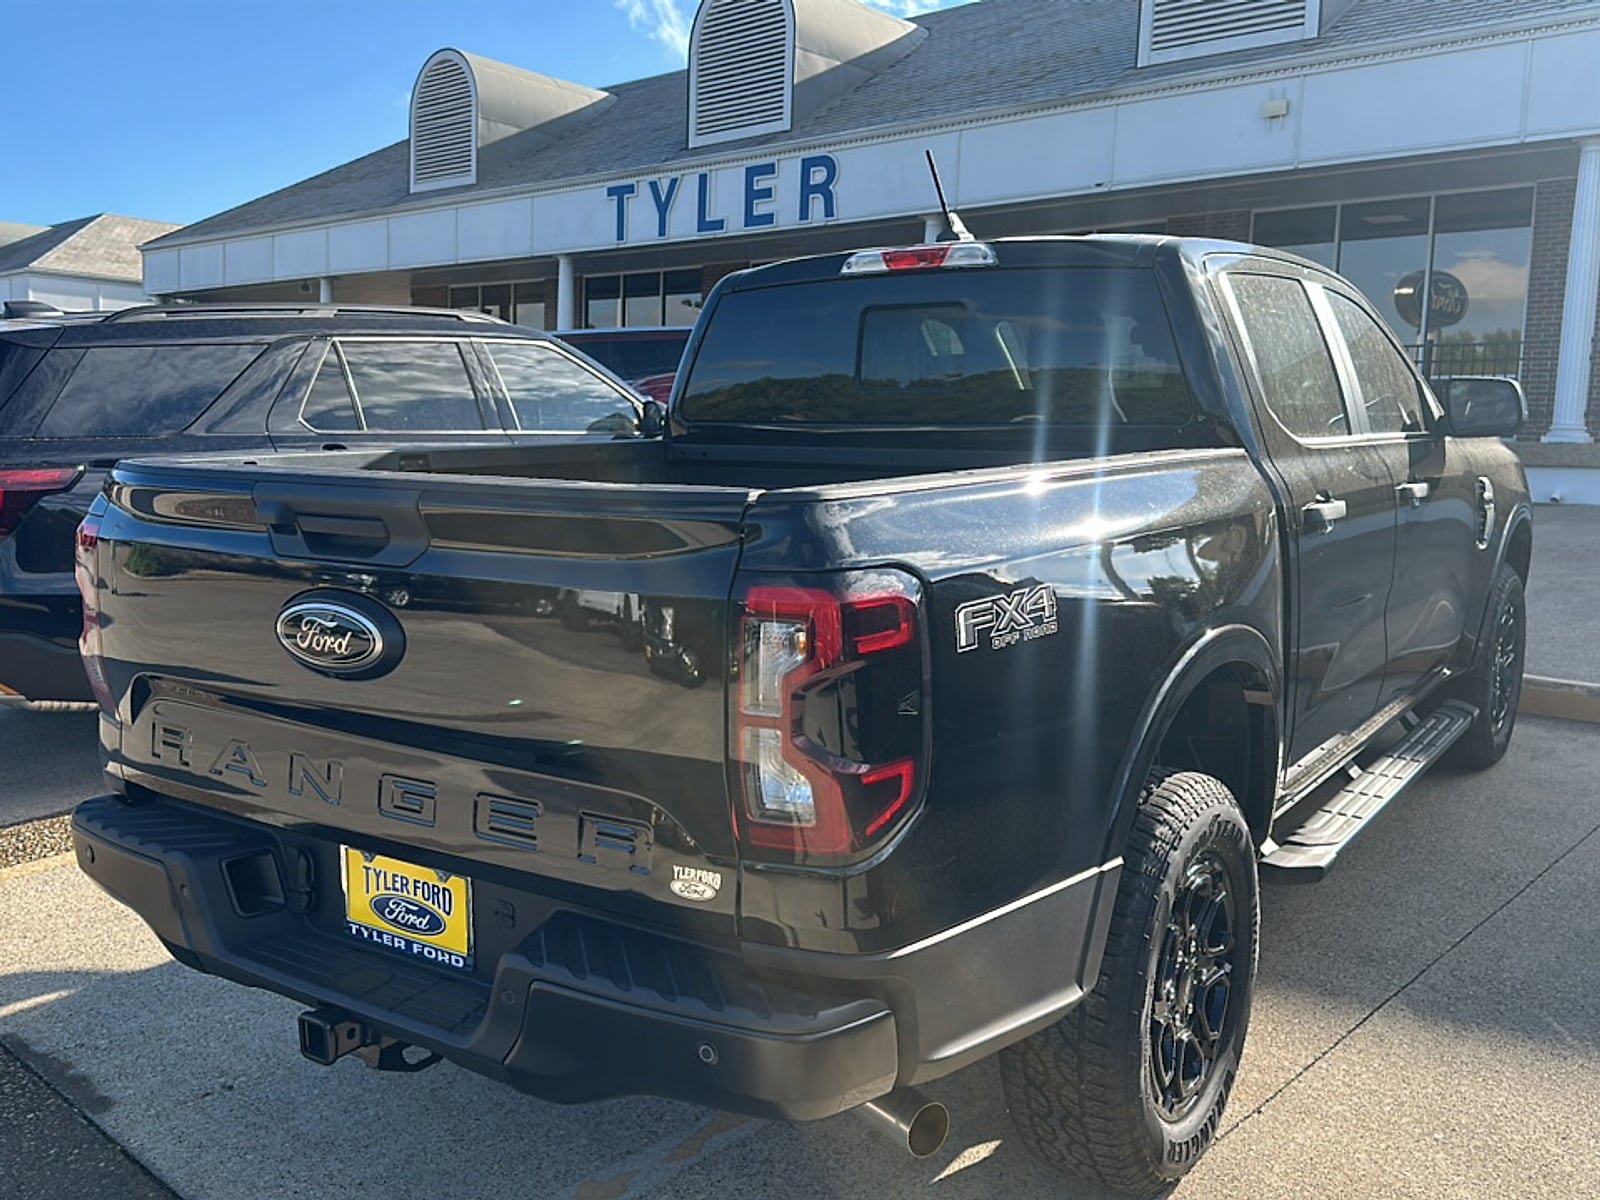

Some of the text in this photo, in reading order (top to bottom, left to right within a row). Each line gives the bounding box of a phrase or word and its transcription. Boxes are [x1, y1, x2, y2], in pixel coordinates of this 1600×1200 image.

[606, 154, 837, 242] TYLER
[296, 616, 353, 656] Ford
[955, 583, 1057, 653] FX4
[991, 621, 1058, 649] OFF ROAD
[151, 720, 654, 877] RANGER
[363, 864, 453, 917] TYLER FORD
[697, 868, 721, 890] FORD
[384, 898, 430, 930] Ford
[348, 923, 465, 968] TYLER FORD
